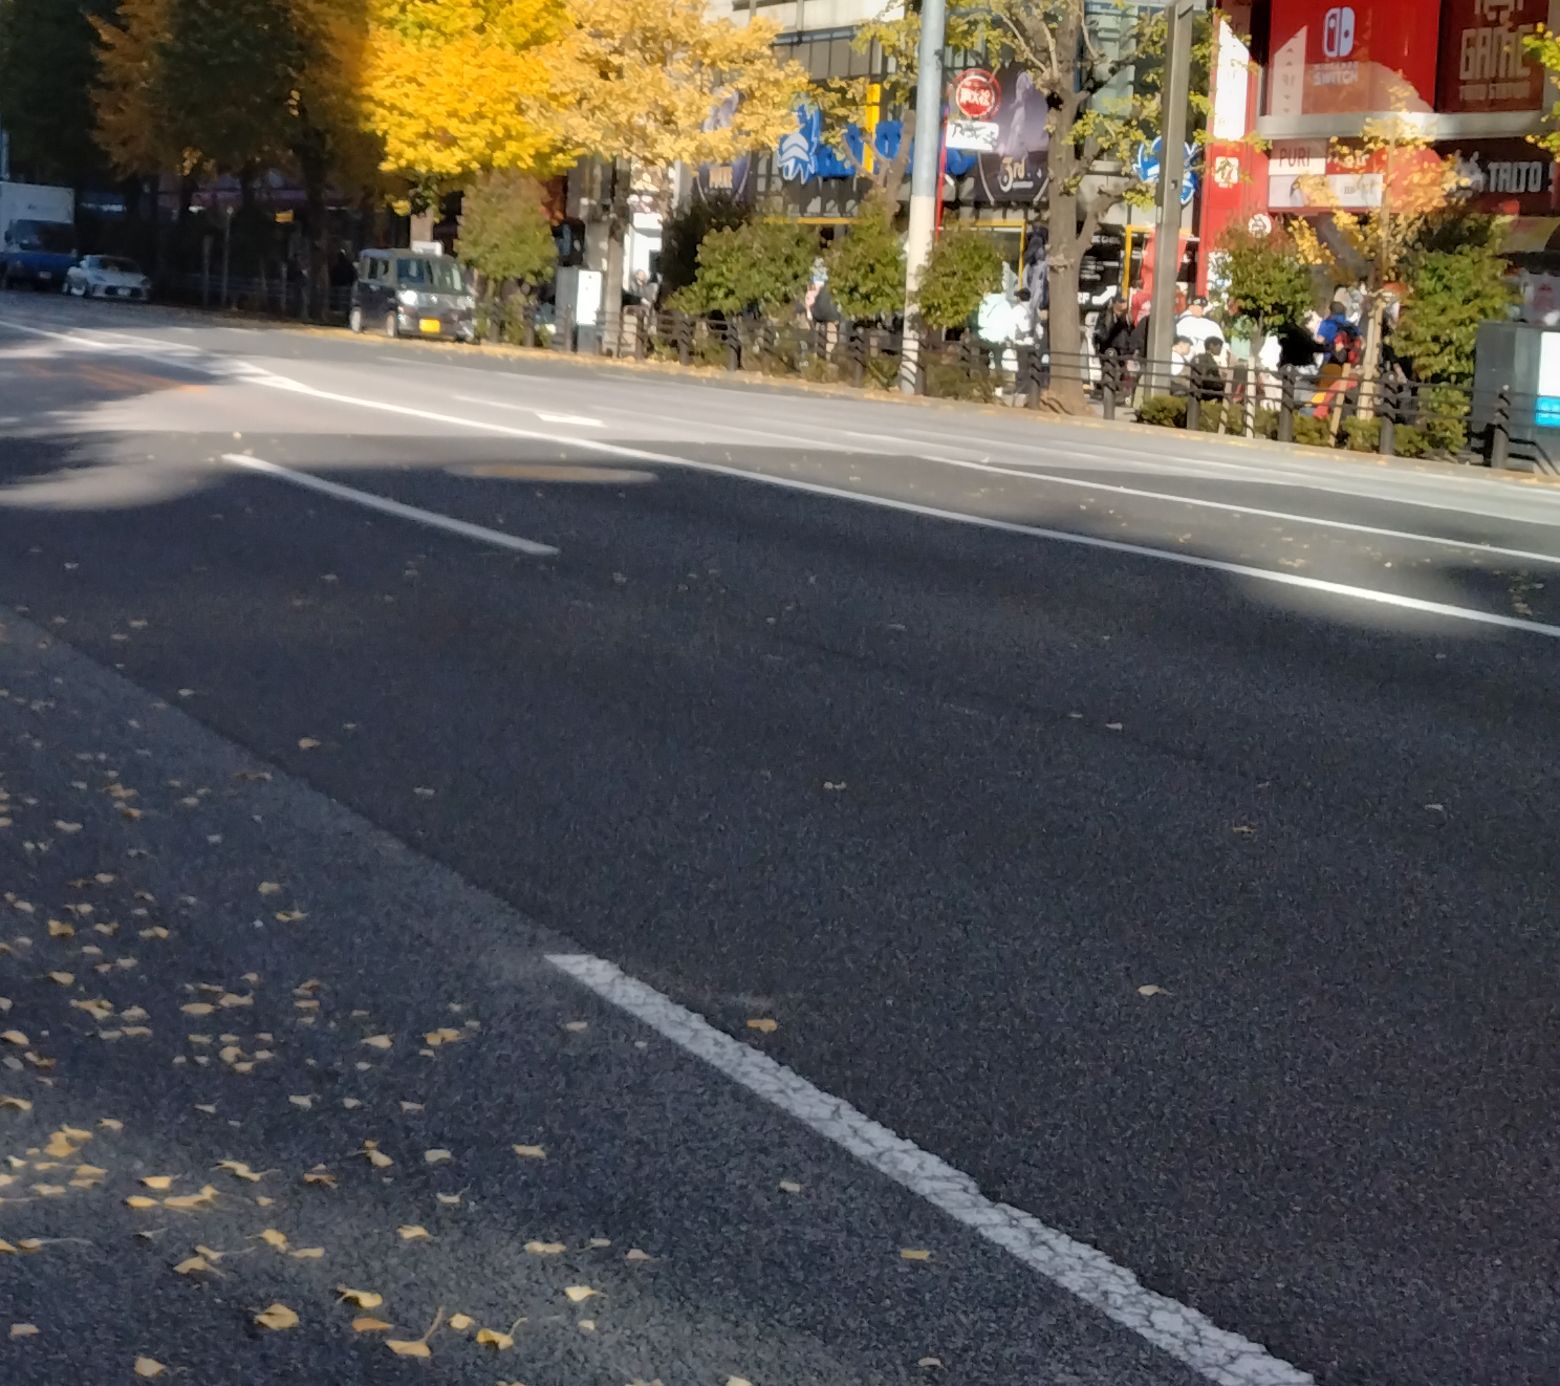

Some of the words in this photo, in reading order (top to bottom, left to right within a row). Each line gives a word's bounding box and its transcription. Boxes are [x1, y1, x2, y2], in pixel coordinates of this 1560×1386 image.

[1459, 24, 1534, 80] GAME
[1278, 146, 1311, 168] PURI
[1488, 161, 1540, 193] TAITO
